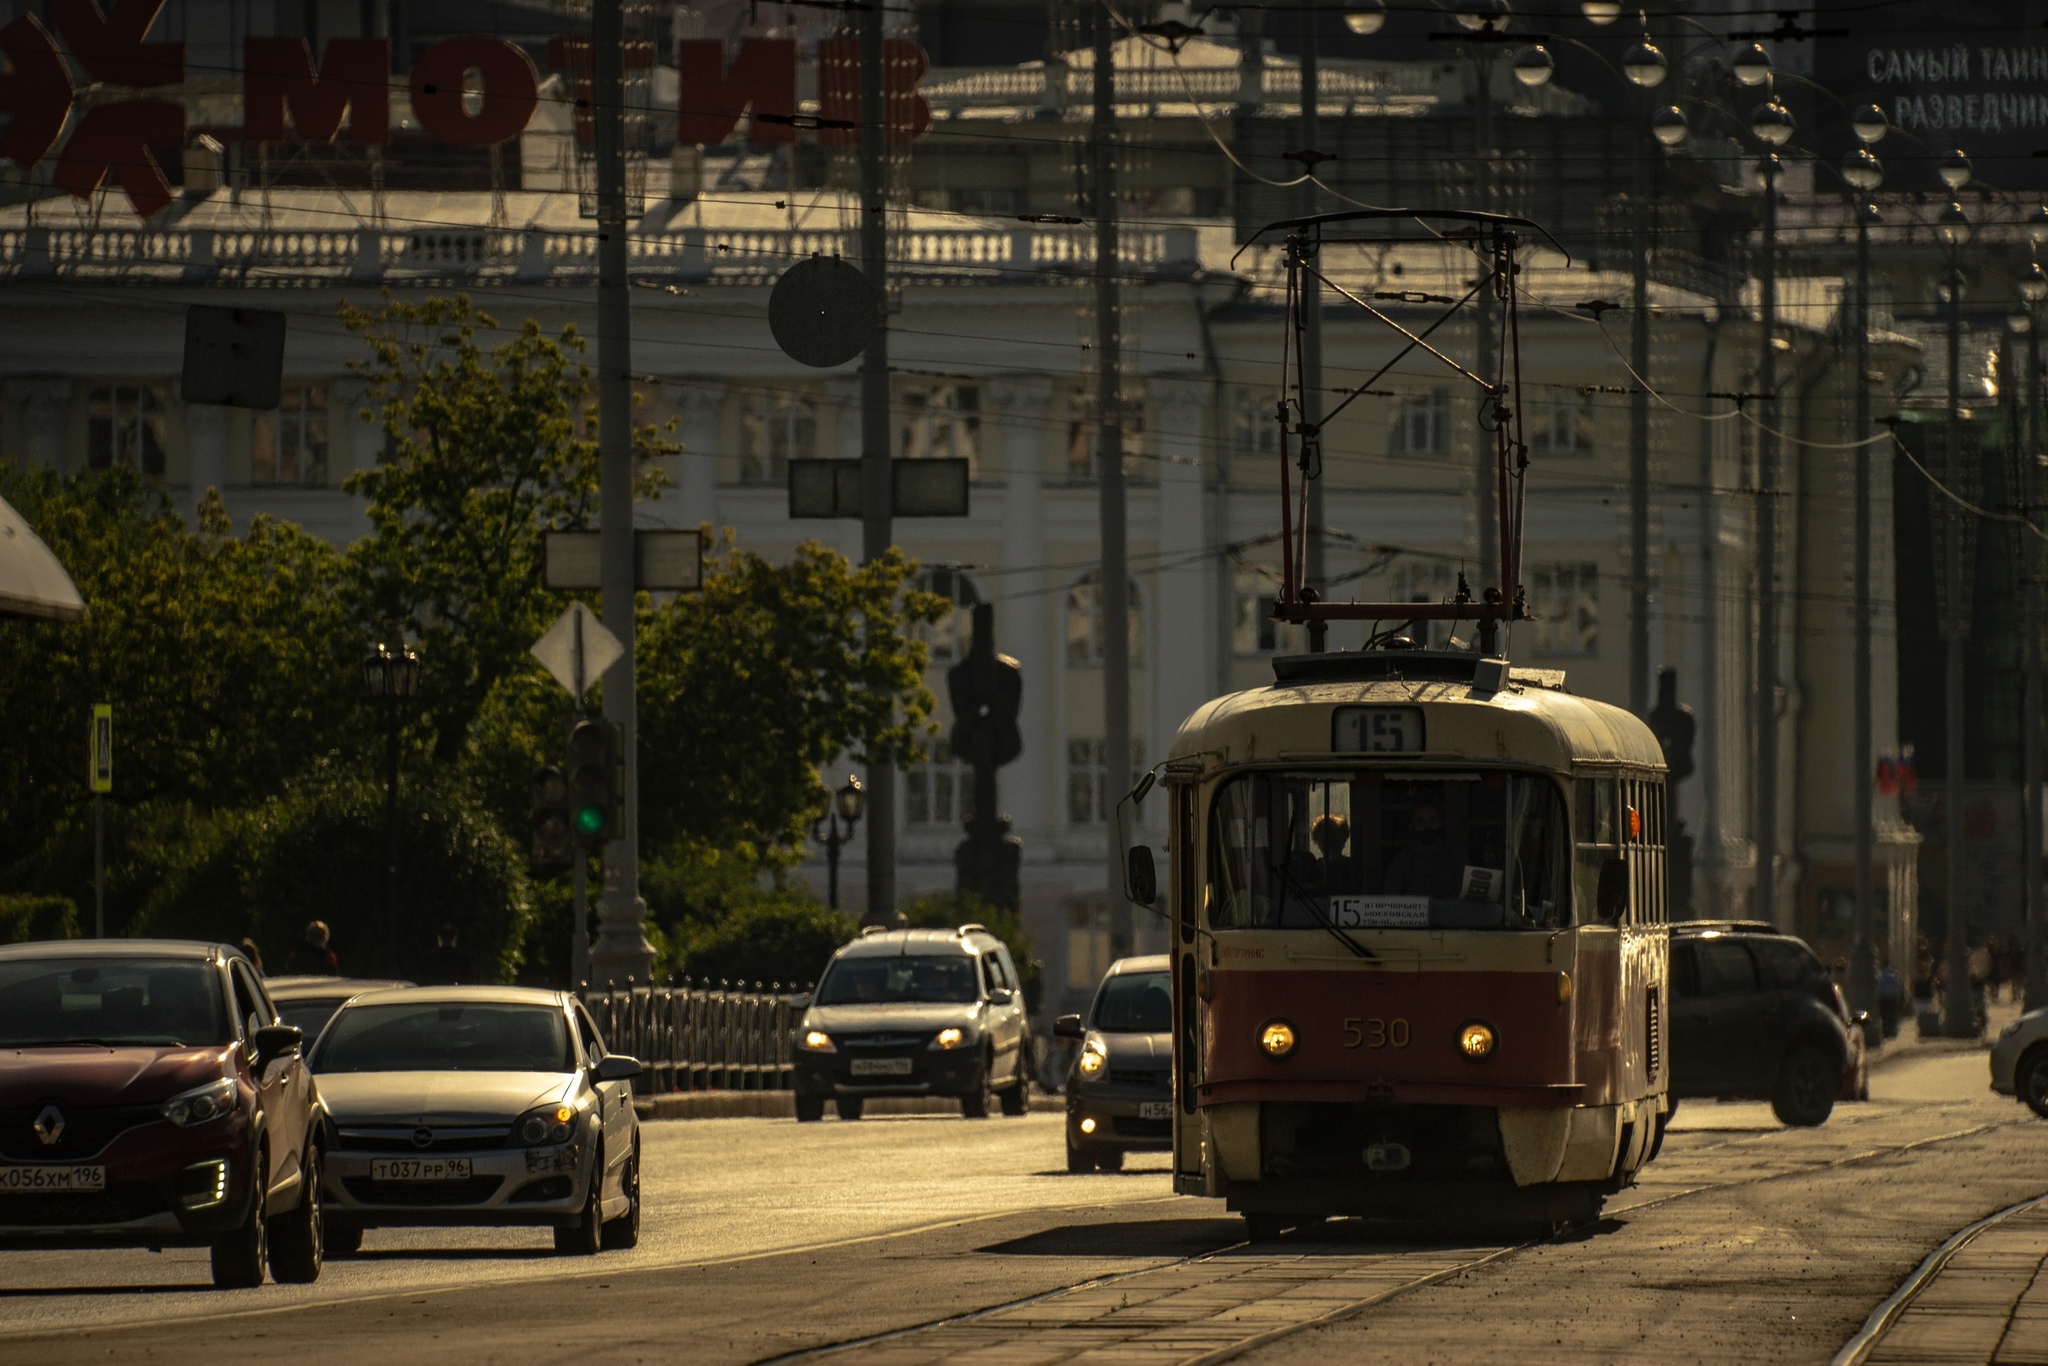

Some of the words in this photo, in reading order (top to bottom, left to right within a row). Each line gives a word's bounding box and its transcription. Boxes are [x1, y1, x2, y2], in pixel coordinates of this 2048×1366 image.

[1867, 43, 1969, 83] САМЫЙ
[244, 36, 931, 146] МОТИВ
[1352, 713, 1403, 752] 15
[1333, 900, 1361, 927] 15
[1344, 1017, 1411, 1048] 530
